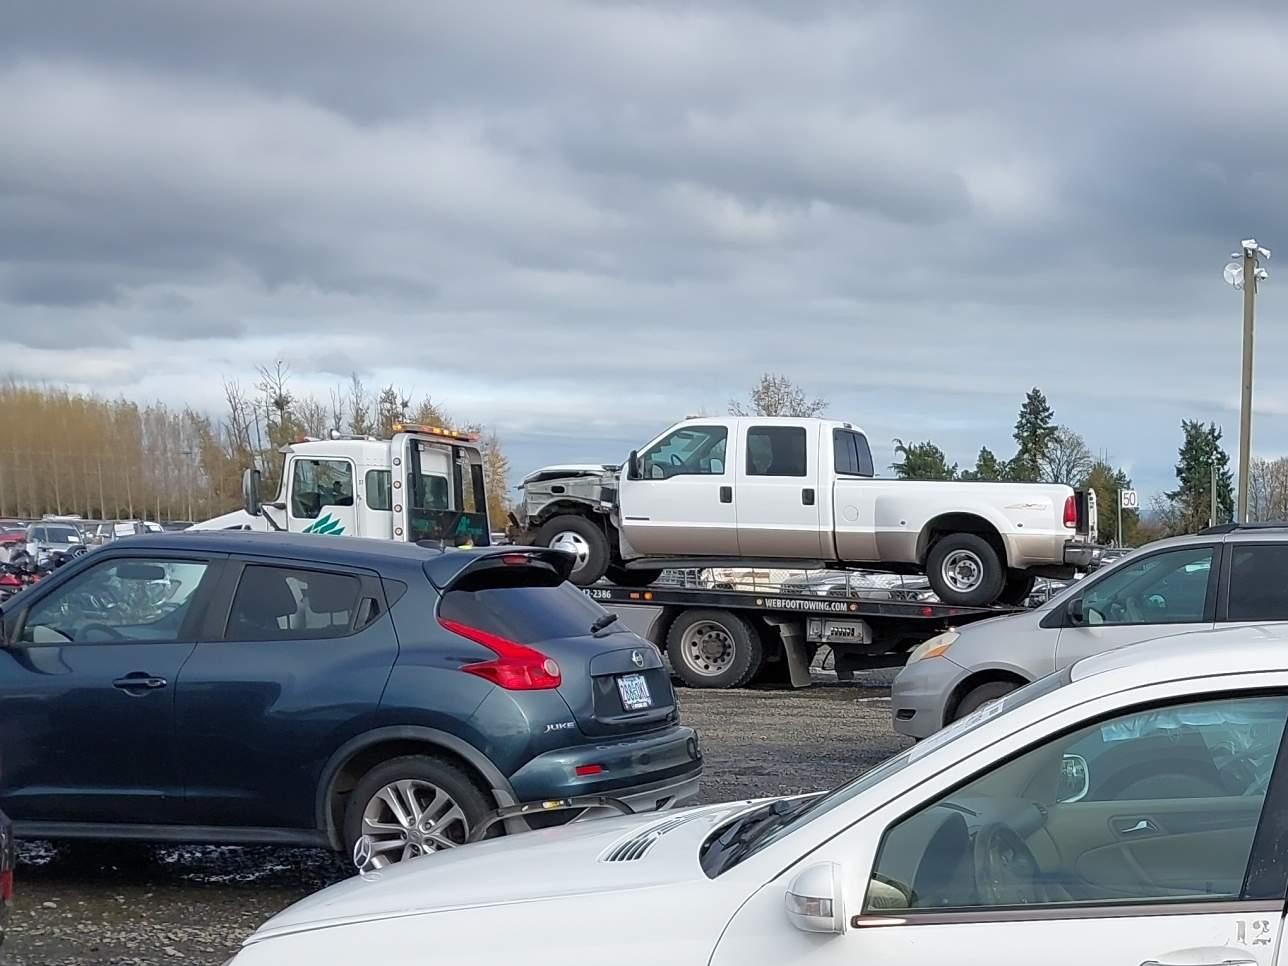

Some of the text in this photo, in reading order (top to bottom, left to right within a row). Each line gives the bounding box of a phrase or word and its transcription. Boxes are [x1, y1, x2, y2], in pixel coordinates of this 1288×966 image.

[1123, 491, 1136, 506] 50
[765, 598, 848, 611] WEBFOOTTOWING.COM
[544, 721, 576, 733] JUKE
[1236, 920, 1272, 945] 12
